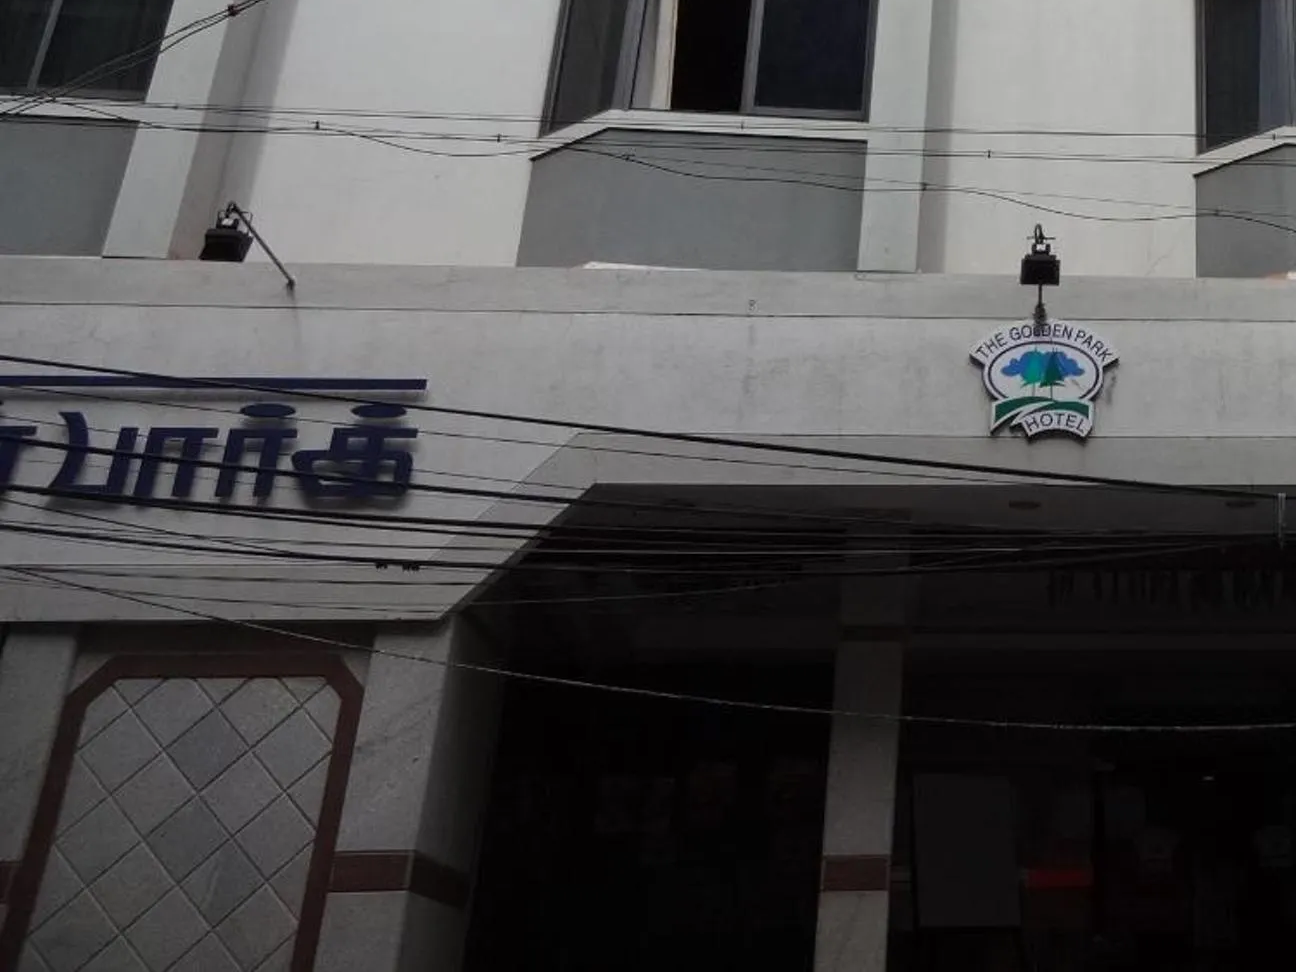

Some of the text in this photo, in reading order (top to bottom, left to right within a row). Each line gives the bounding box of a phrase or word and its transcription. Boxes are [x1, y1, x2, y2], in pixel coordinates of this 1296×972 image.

[976, 333, 1007, 358] THE
[1074, 330, 1113, 363] PARK
[1024, 413, 1086, 434] HOTEL
